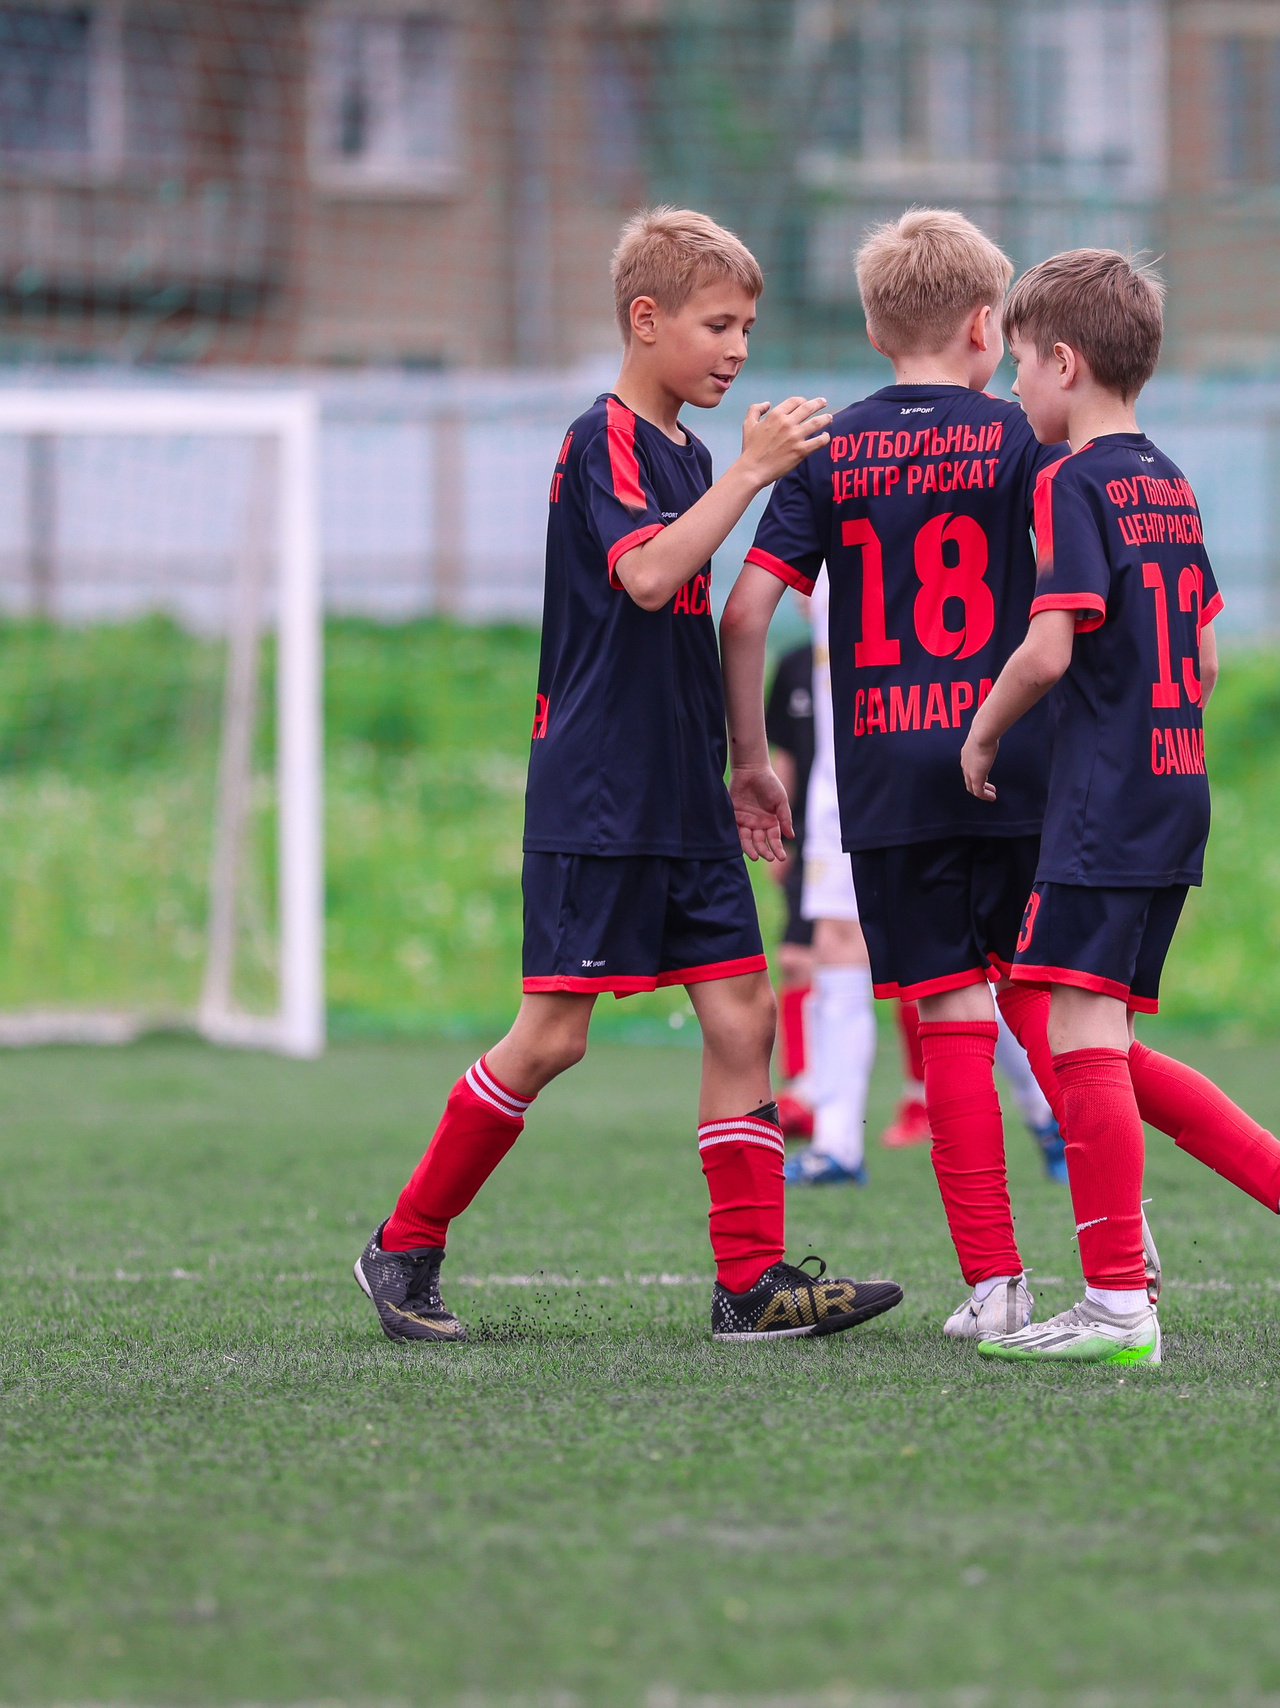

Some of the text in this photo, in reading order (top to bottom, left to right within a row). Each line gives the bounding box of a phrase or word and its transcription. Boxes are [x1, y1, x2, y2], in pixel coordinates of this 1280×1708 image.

[830, 421, 1004, 463] ФУТБОЛЬНЫЙ
[832, 458, 999, 504] ЦЕНТР РАСКАТ
[1117, 512, 1166, 547] ЦЕНТР
[841, 512, 995, 668] 18
[1141, 562, 1204, 708] 13
[753, 1282, 857, 1332] AIR
